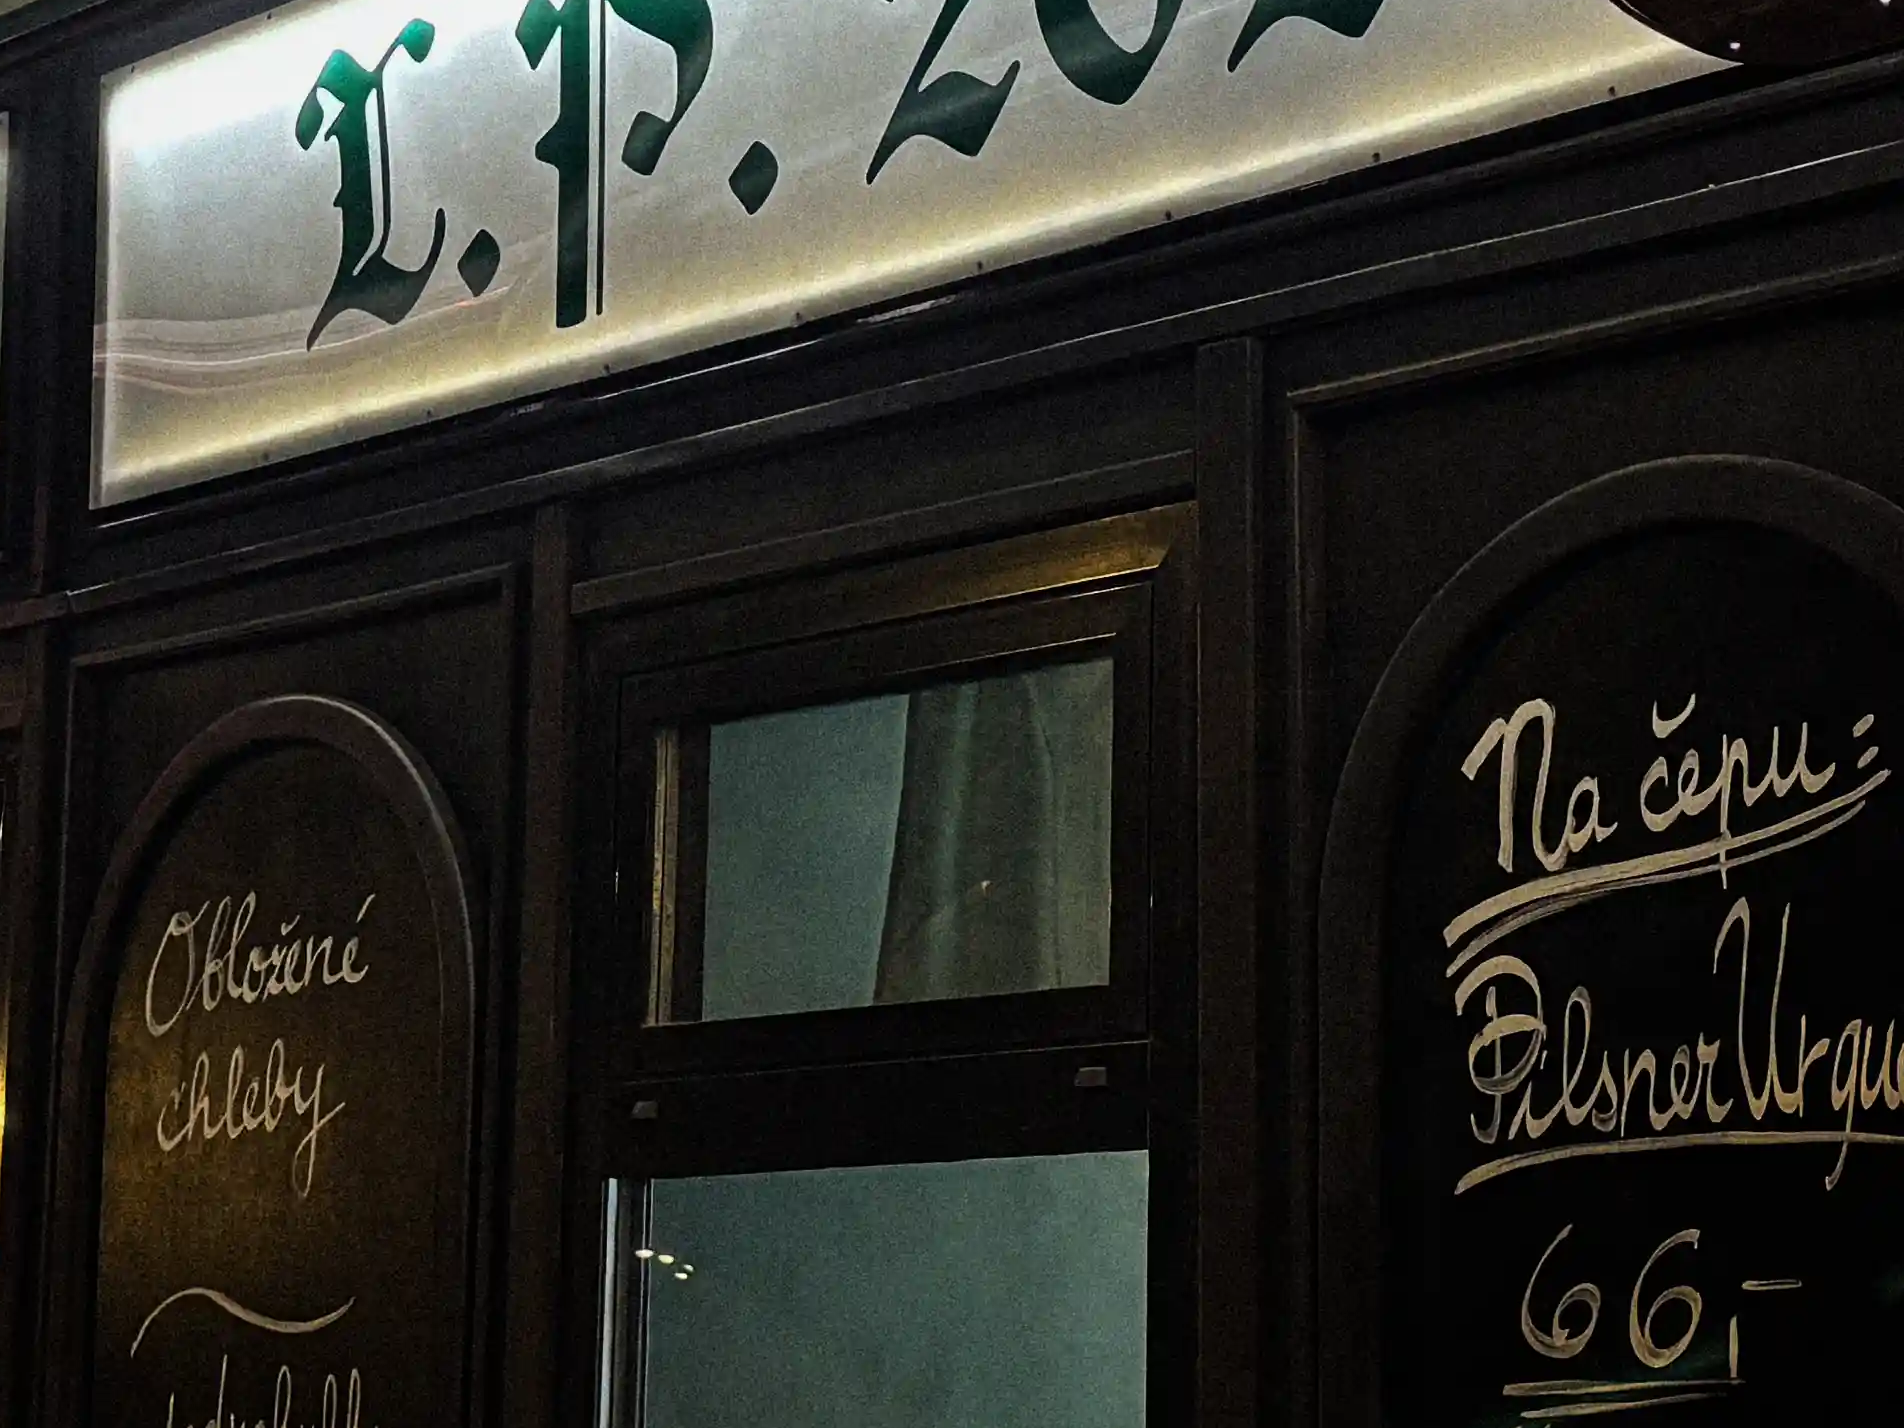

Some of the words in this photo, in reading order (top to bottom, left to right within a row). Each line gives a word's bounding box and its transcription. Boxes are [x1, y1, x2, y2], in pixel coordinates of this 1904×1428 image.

[1460, 698, 1619, 873] Na
[146, 889, 377, 1037] Obložené
[1453, 955, 1734, 1143] Pilsner
